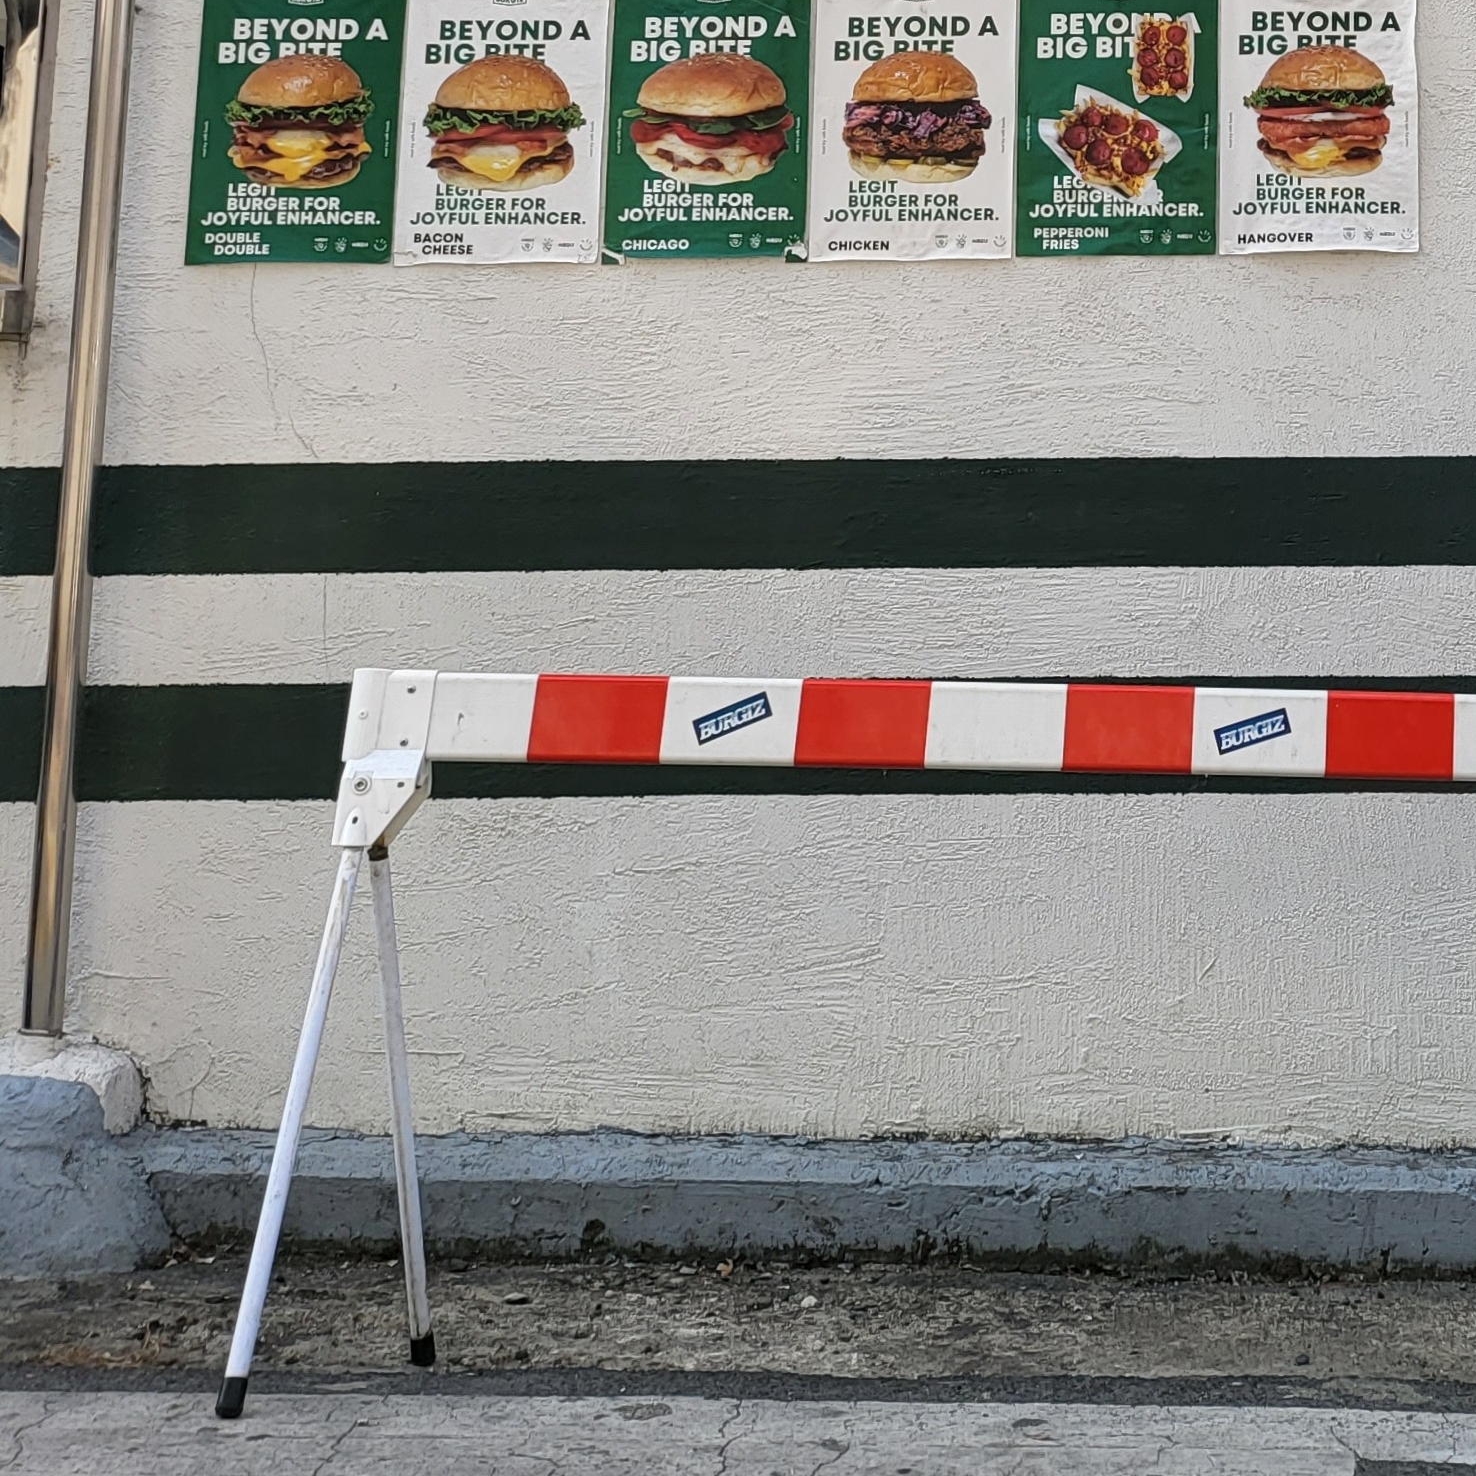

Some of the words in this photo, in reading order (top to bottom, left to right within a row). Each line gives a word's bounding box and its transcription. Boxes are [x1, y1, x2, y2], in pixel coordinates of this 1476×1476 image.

[645, 16, 767, 38] BEYOND
[774, 16, 796, 37] A
[848, 16, 970, 37] BEYOND
[978, 16, 999, 36] A
[1252, 11, 1372, 32] BEYOND
[1380, 12, 1401, 31] A
[233, 18, 359, 40] BEYOND
[365, 19, 388, 40] A
[440, 20, 562, 41] BEYOND
[569, 20, 591, 40] A
[630, 40, 681, 62] BIG
[689, 40, 752, 57] BITE
[834, 40, 884, 61] BIG
[1037, 37, 1088, 58] BIG
[1096, 36, 1136, 58] BIT
[1239, 35, 1288, 55] BIG
[218, 42, 270, 64] BIG
[279, 42, 342, 60] BITE
[425, 44, 476, 64] BIG
[485, 44, 546, 63] BITE
[643, 179, 690, 193] LEGIT
[1053, 176, 1091, 188] LEG
[1256, 174, 1301, 186] LEGIT
[849, 181, 898, 193] LEGIT
[1256, 187, 1326, 200] BURGER
[1331, 188, 1365, 200] FOR
[227, 197, 299, 210] BURGER
[304, 197, 340, 210] FOR
[435, 198, 505, 210] BURGER
[511, 198, 546, 210] FOR
[642, 194, 713, 207] BURGER
[718, 193, 753, 206] FOR
[849, 195, 919, 207] BURGER
[924, 194, 958, 206] FOR
[618, 208, 687, 221] JOYFUL
[692, 207, 794, 221] ENHANCER.
[824, 209, 893, 222] JOYFUL
[898, 208, 999, 221] ENHANCER.
[1029, 204, 1099, 218] JOYFUL
[1103, 203, 1204, 217] ENHANCER.
[1233, 202, 1301, 215] JOYFUL
[1305, 202, 1406, 214] ENHANCER.
[201, 212, 272, 225] JOYFUL
[276, 212, 380, 225] ENHANCER.
[410, 212, 479, 225] JOYFUL
[484, 212, 586, 224] ENHANCER.
[205, 233, 261, 243] DOUBLE
[414, 233, 463, 243] BACON
[1034, 228, 1109, 238] PEPPERONI
[1238, 233, 1313, 244] HANGOVER
[214, 244, 270, 255] DOUBLE
[422, 245, 473, 254] CHEESE
[622, 239, 689, 250] CHICAGO
[828, 241, 890, 251] CHICKEN
[1043, 239, 1079, 250] FRIES
[699, 698, 766, 741] BURGIZ
[1220, 714, 1286, 751] BURGIZ
